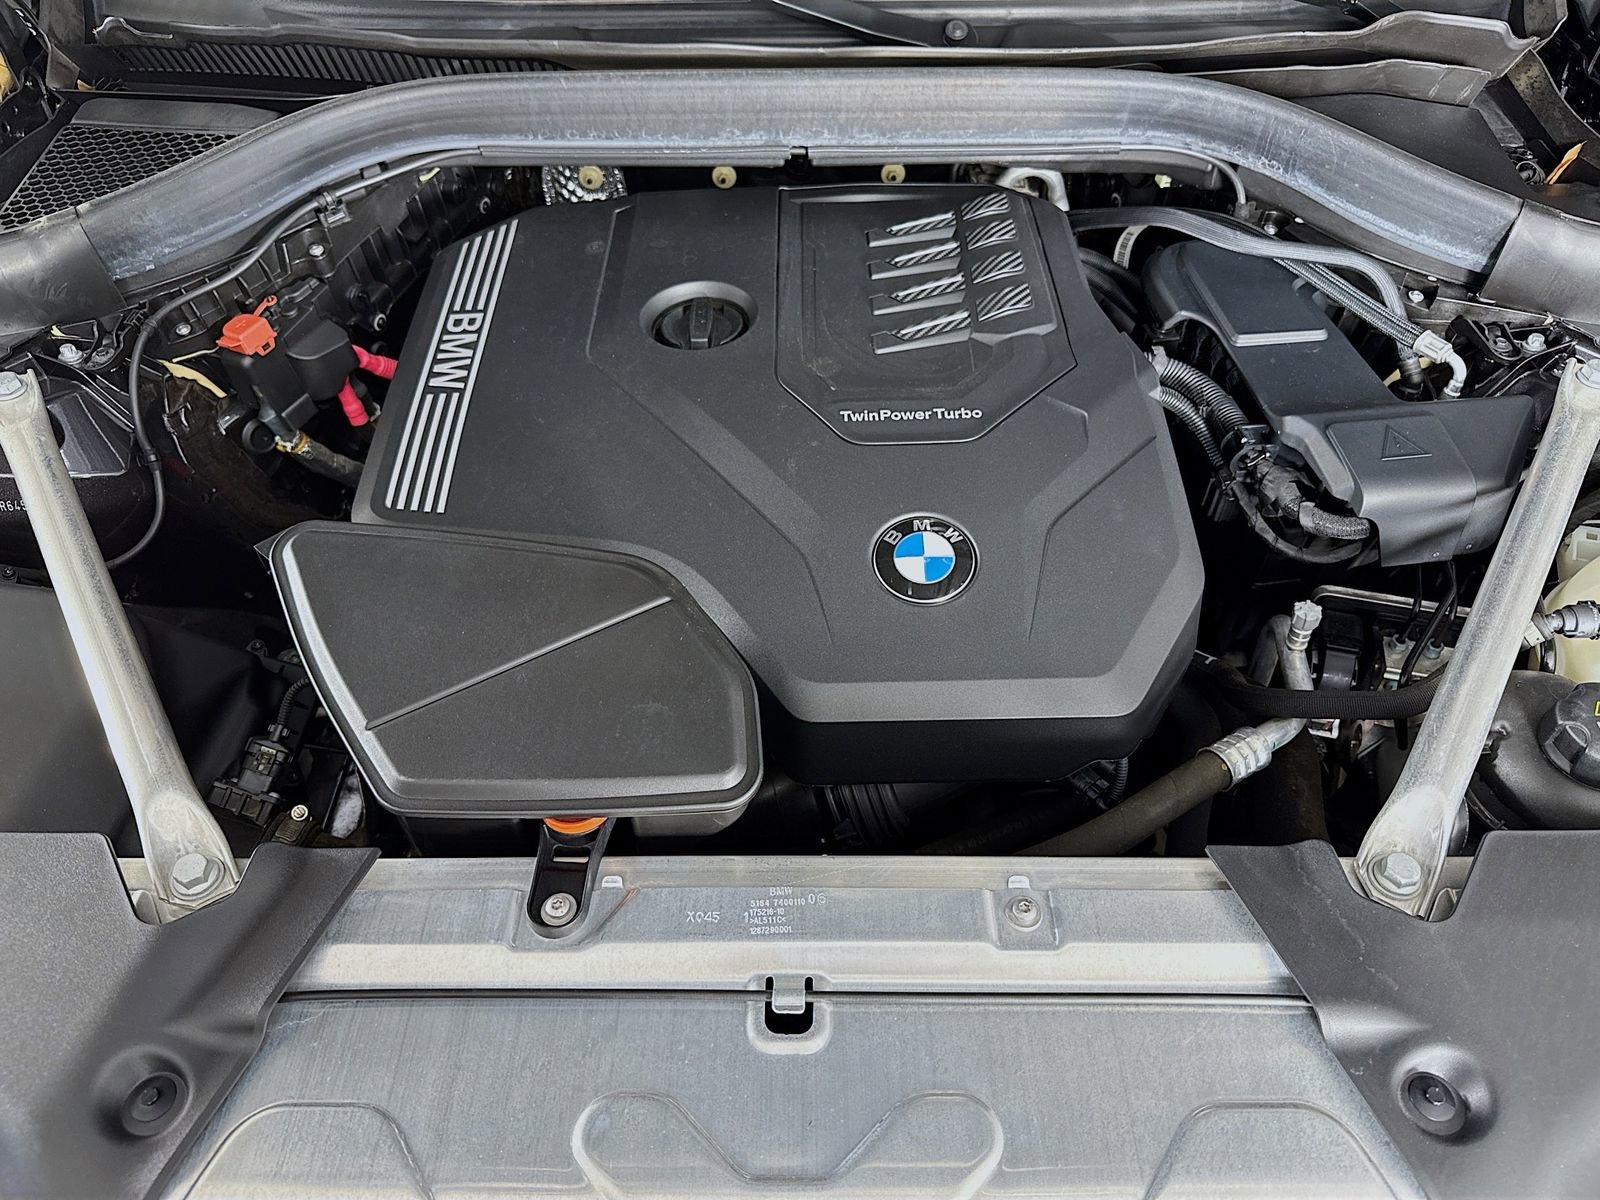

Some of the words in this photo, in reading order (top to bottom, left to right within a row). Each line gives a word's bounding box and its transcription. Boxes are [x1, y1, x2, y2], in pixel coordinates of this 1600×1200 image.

[428, 312, 484, 389] BMW
[839, 409, 932, 421] TwinPower
[933, 407, 983, 419] Turbo
[883, 519, 964, 546] BMW
[770, 886, 794, 896] BMW
